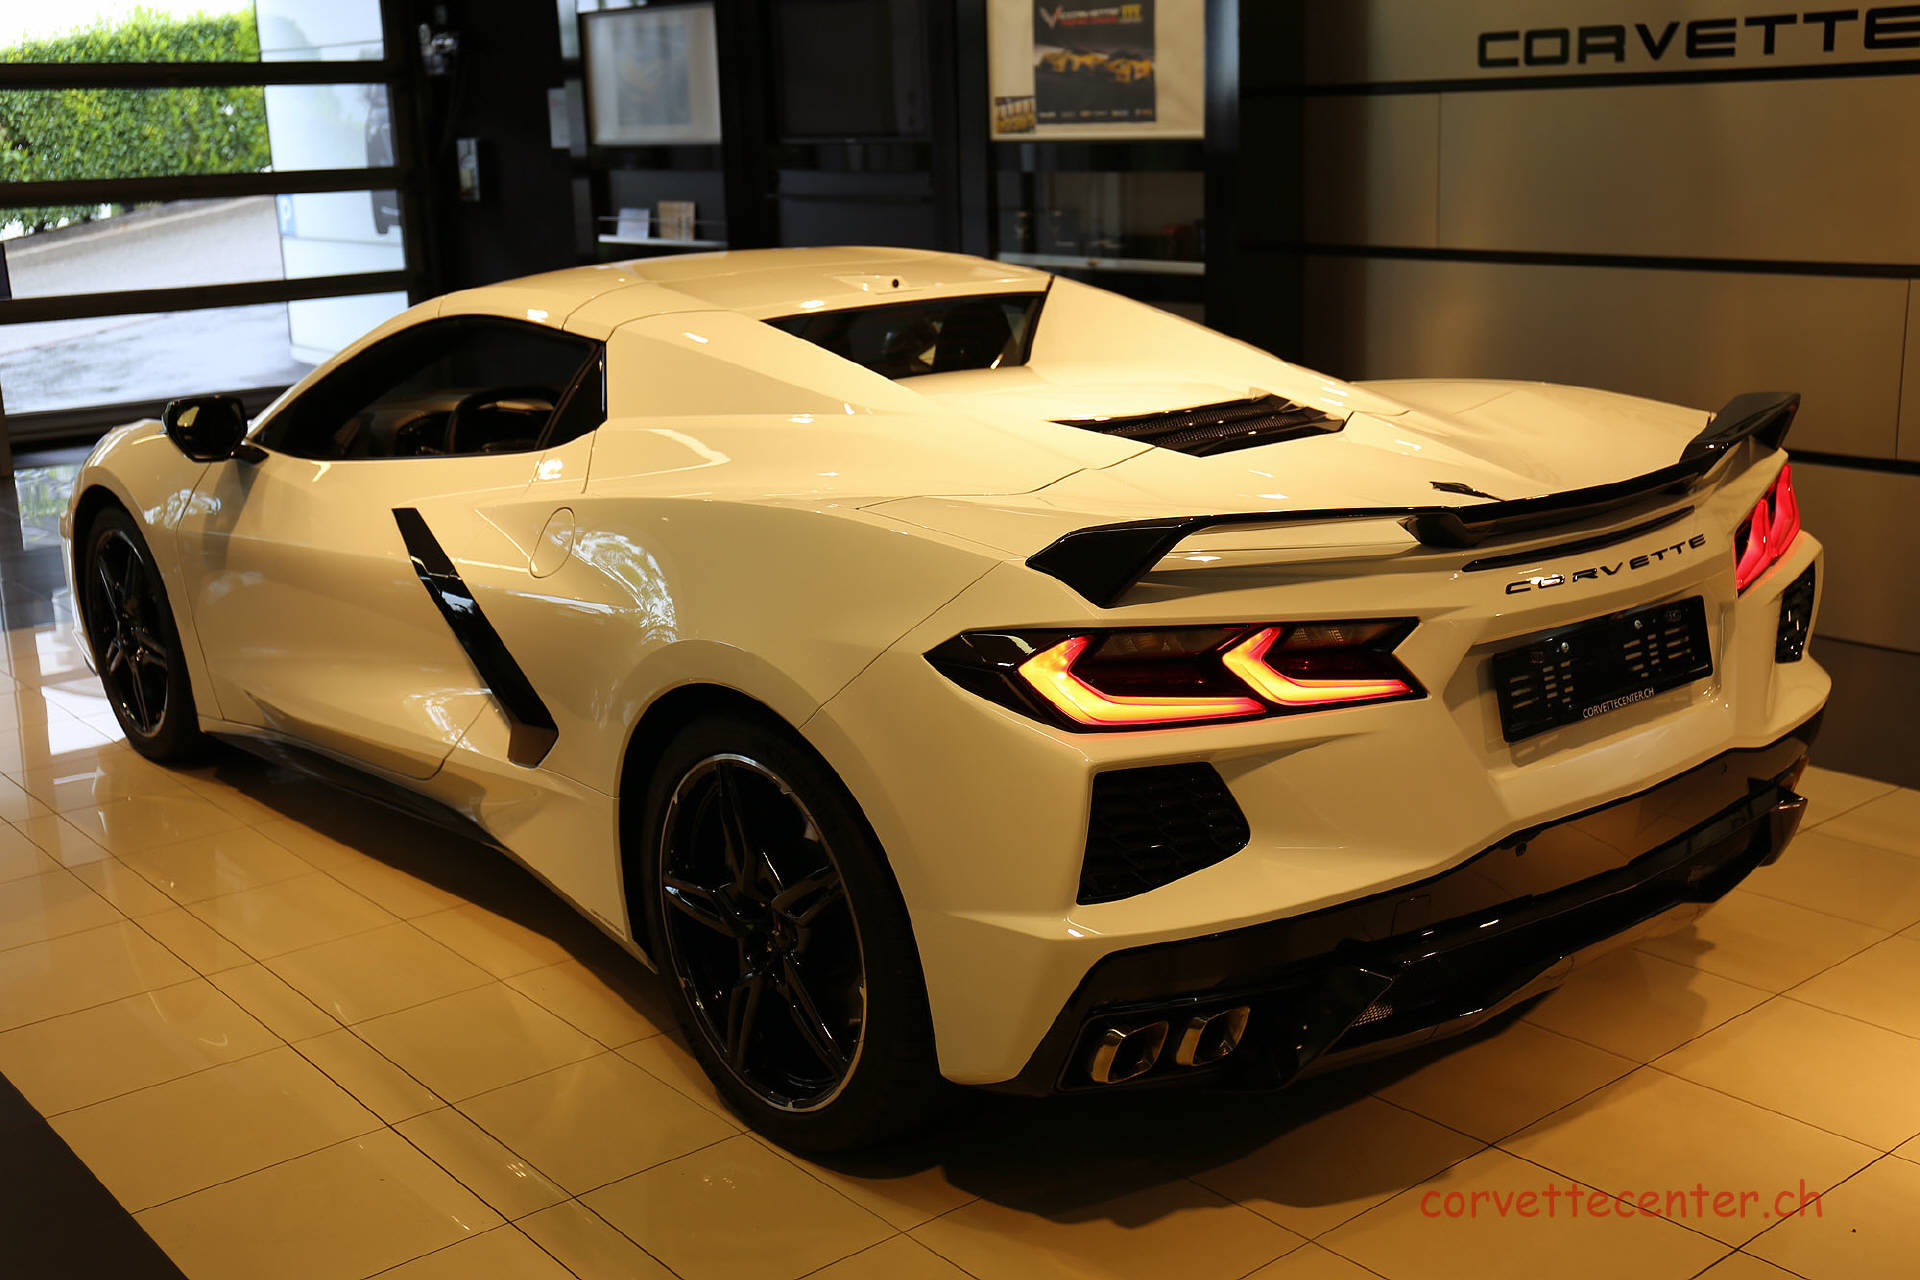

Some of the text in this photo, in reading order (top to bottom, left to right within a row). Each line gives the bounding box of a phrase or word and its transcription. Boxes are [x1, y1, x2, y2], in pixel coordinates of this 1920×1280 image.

[1478, 5, 1920, 68] CORVETTE
[1505, 533, 1706, 595] CORVETTE
[1582, 687, 1655, 719] CORVETTECENTER.CH
